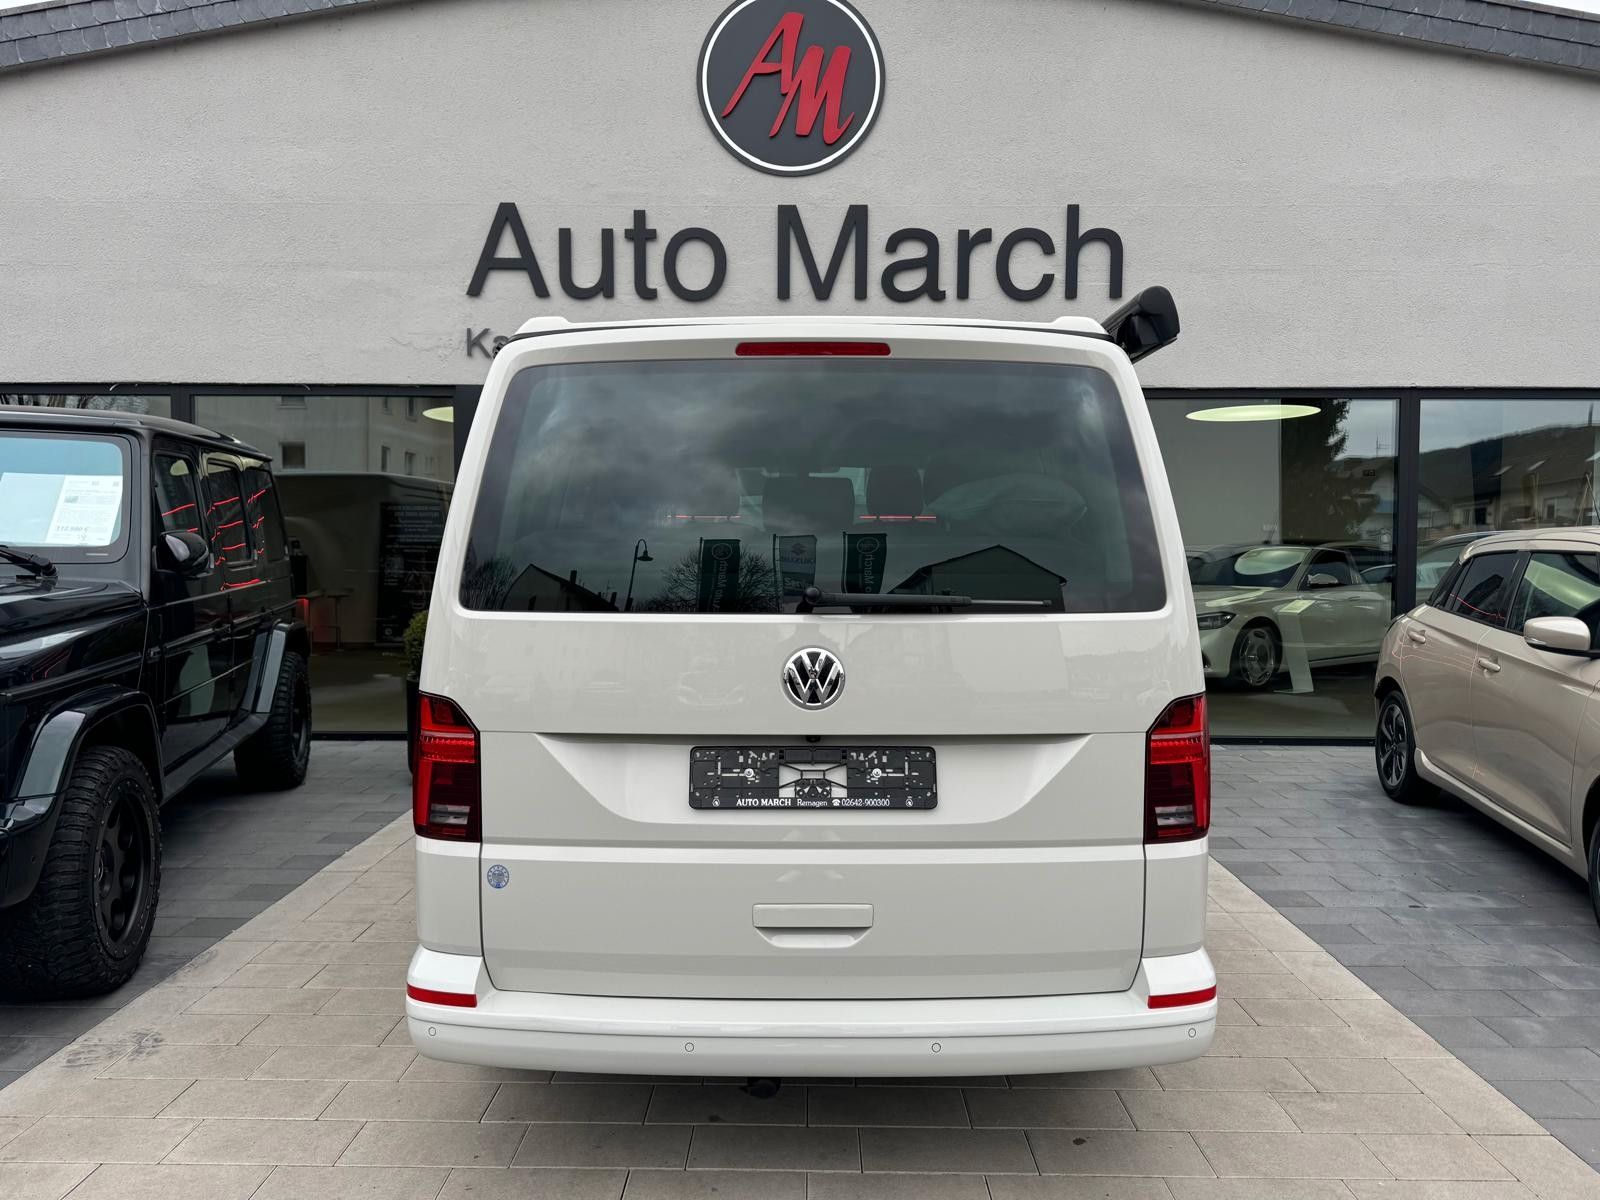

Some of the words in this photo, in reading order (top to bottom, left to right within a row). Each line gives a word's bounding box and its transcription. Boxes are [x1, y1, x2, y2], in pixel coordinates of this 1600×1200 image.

[723, 12, 853, 145] AM
[467, 203, 727, 302] Auto
[777, 204, 1123, 303] March
[783, 648, 846, 711] VW
[736, 798, 759, 807] AUTO
[760, 798, 792, 807] MARCH
[797, 798, 828, 808] Remagen
[841, 798, 890, 807] 02642-900300
